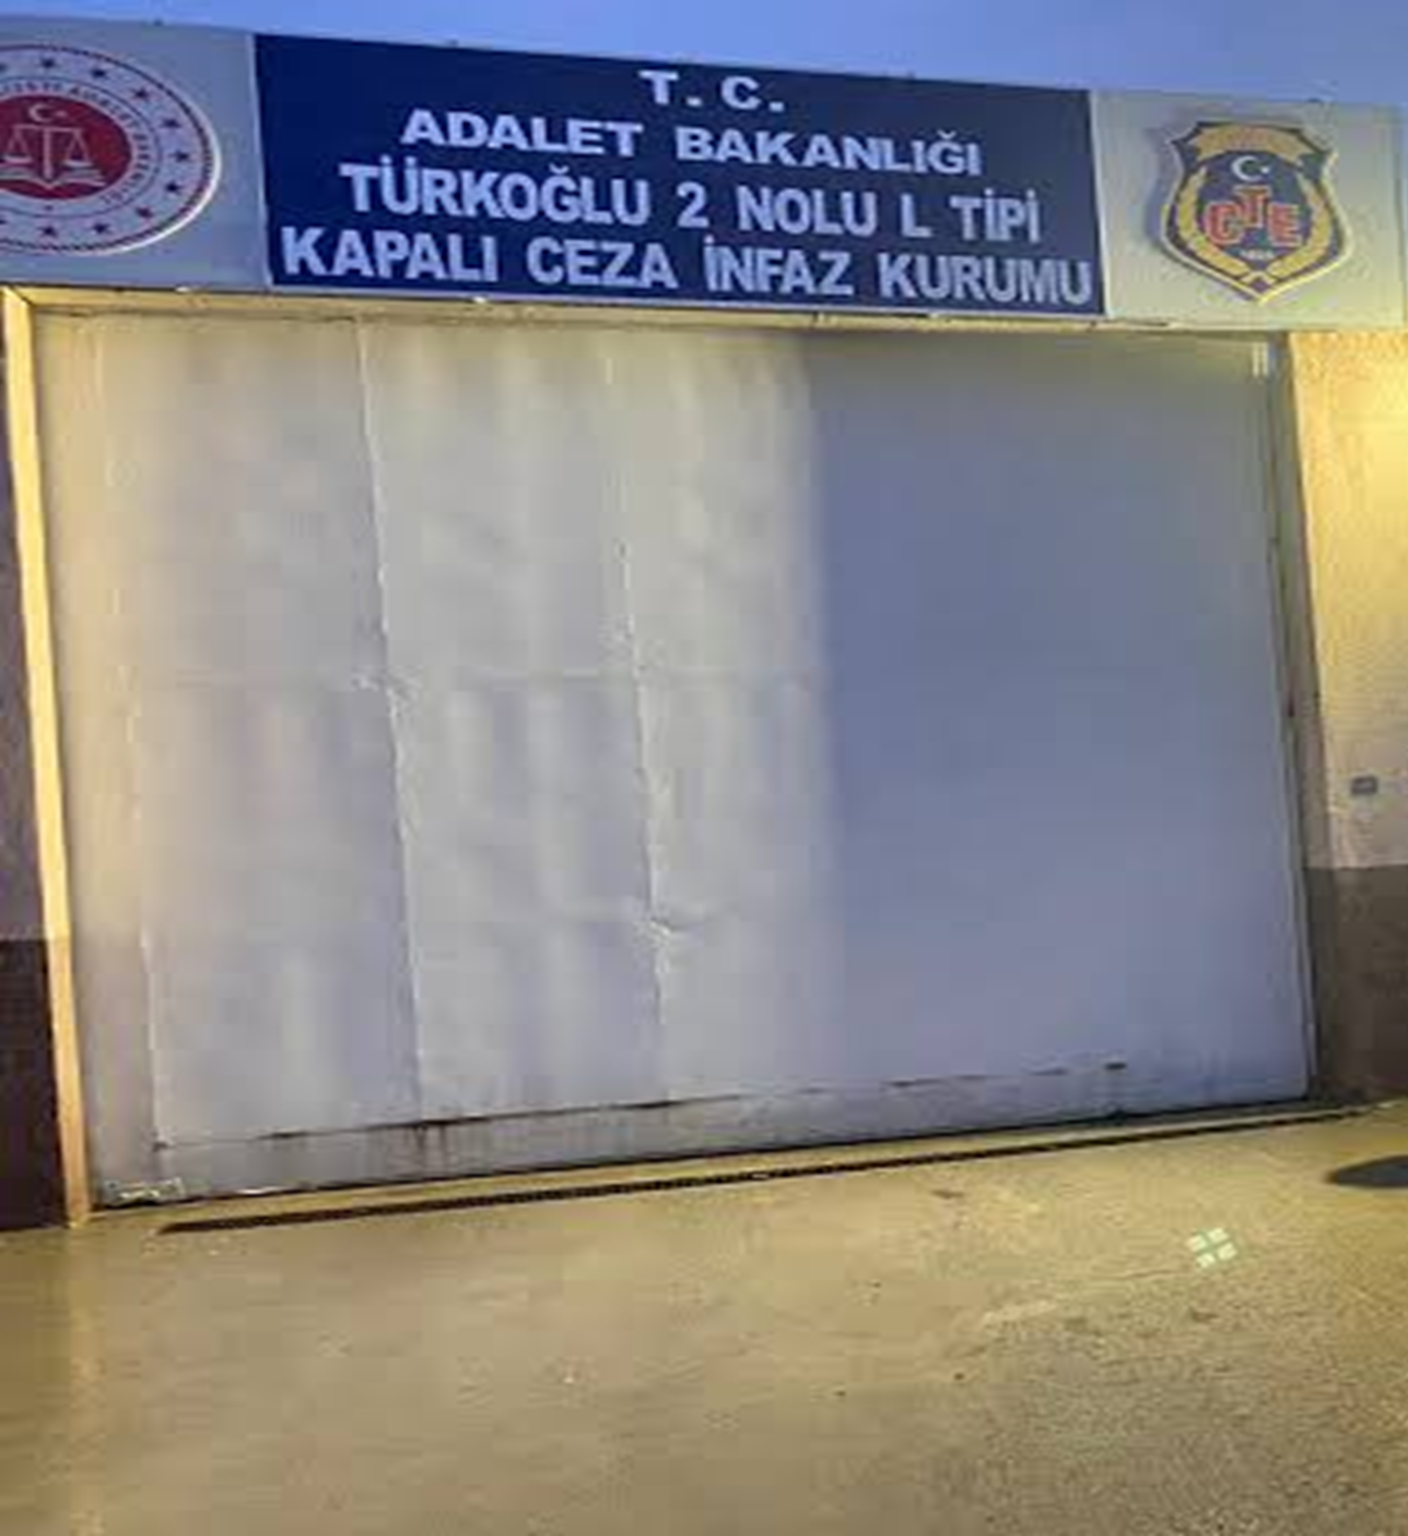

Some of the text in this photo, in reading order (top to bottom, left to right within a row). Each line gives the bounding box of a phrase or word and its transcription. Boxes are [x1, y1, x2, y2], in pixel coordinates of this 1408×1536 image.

[638, 70, 784, 112] T. C.
[401, 108, 982, 176] ADALET BAKANLIĞI
[338, 154, 1041, 243] TÜRKOĞLU 2 NOLU L TİPİ
[1204, 186, 1303, 248] CTE
[281, 226, 1092, 306] KAPALI CEZA İNFAZ KURUMU
